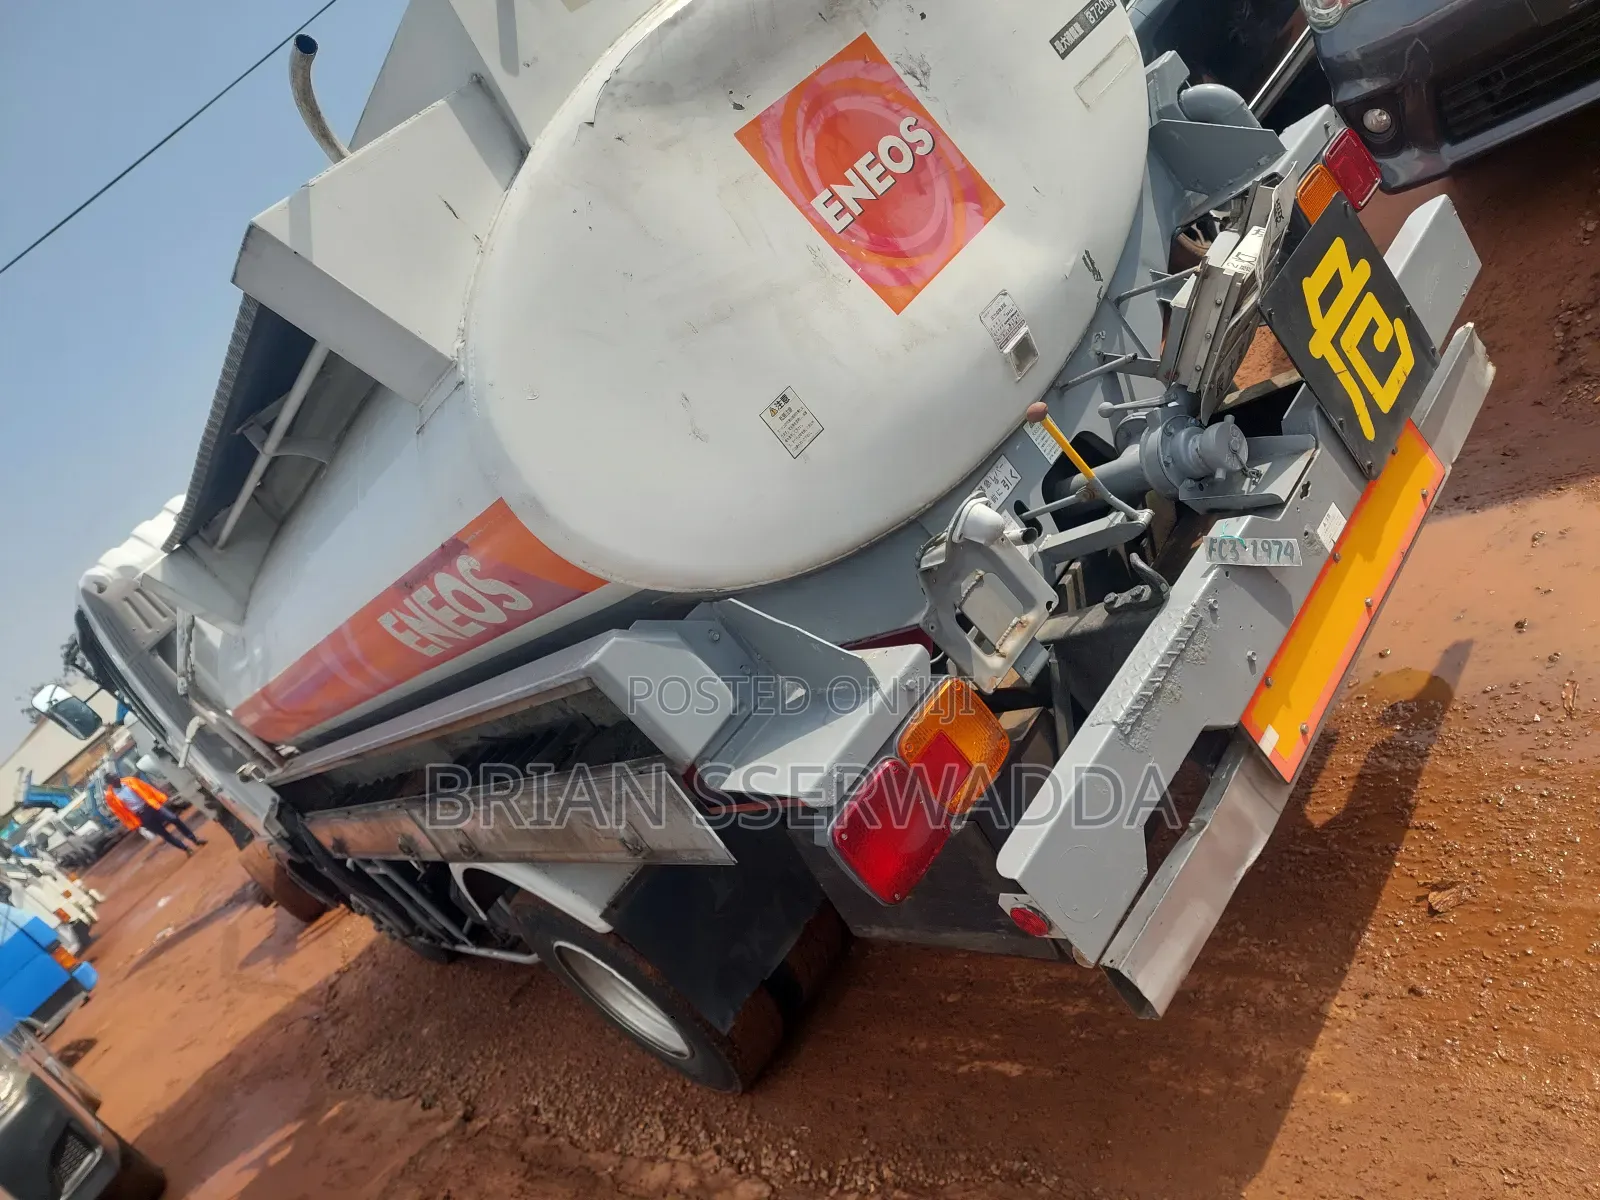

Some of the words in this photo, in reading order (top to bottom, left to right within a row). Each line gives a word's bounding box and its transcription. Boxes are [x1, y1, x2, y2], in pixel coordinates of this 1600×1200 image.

[810, 116, 936, 235] ENEOS
[1302, 236, 1415, 441] 危
[773, 393, 791, 411] 注意
[1250, 539, 1295, 564] 1974
[376, 554, 534, 658] ENEOS
